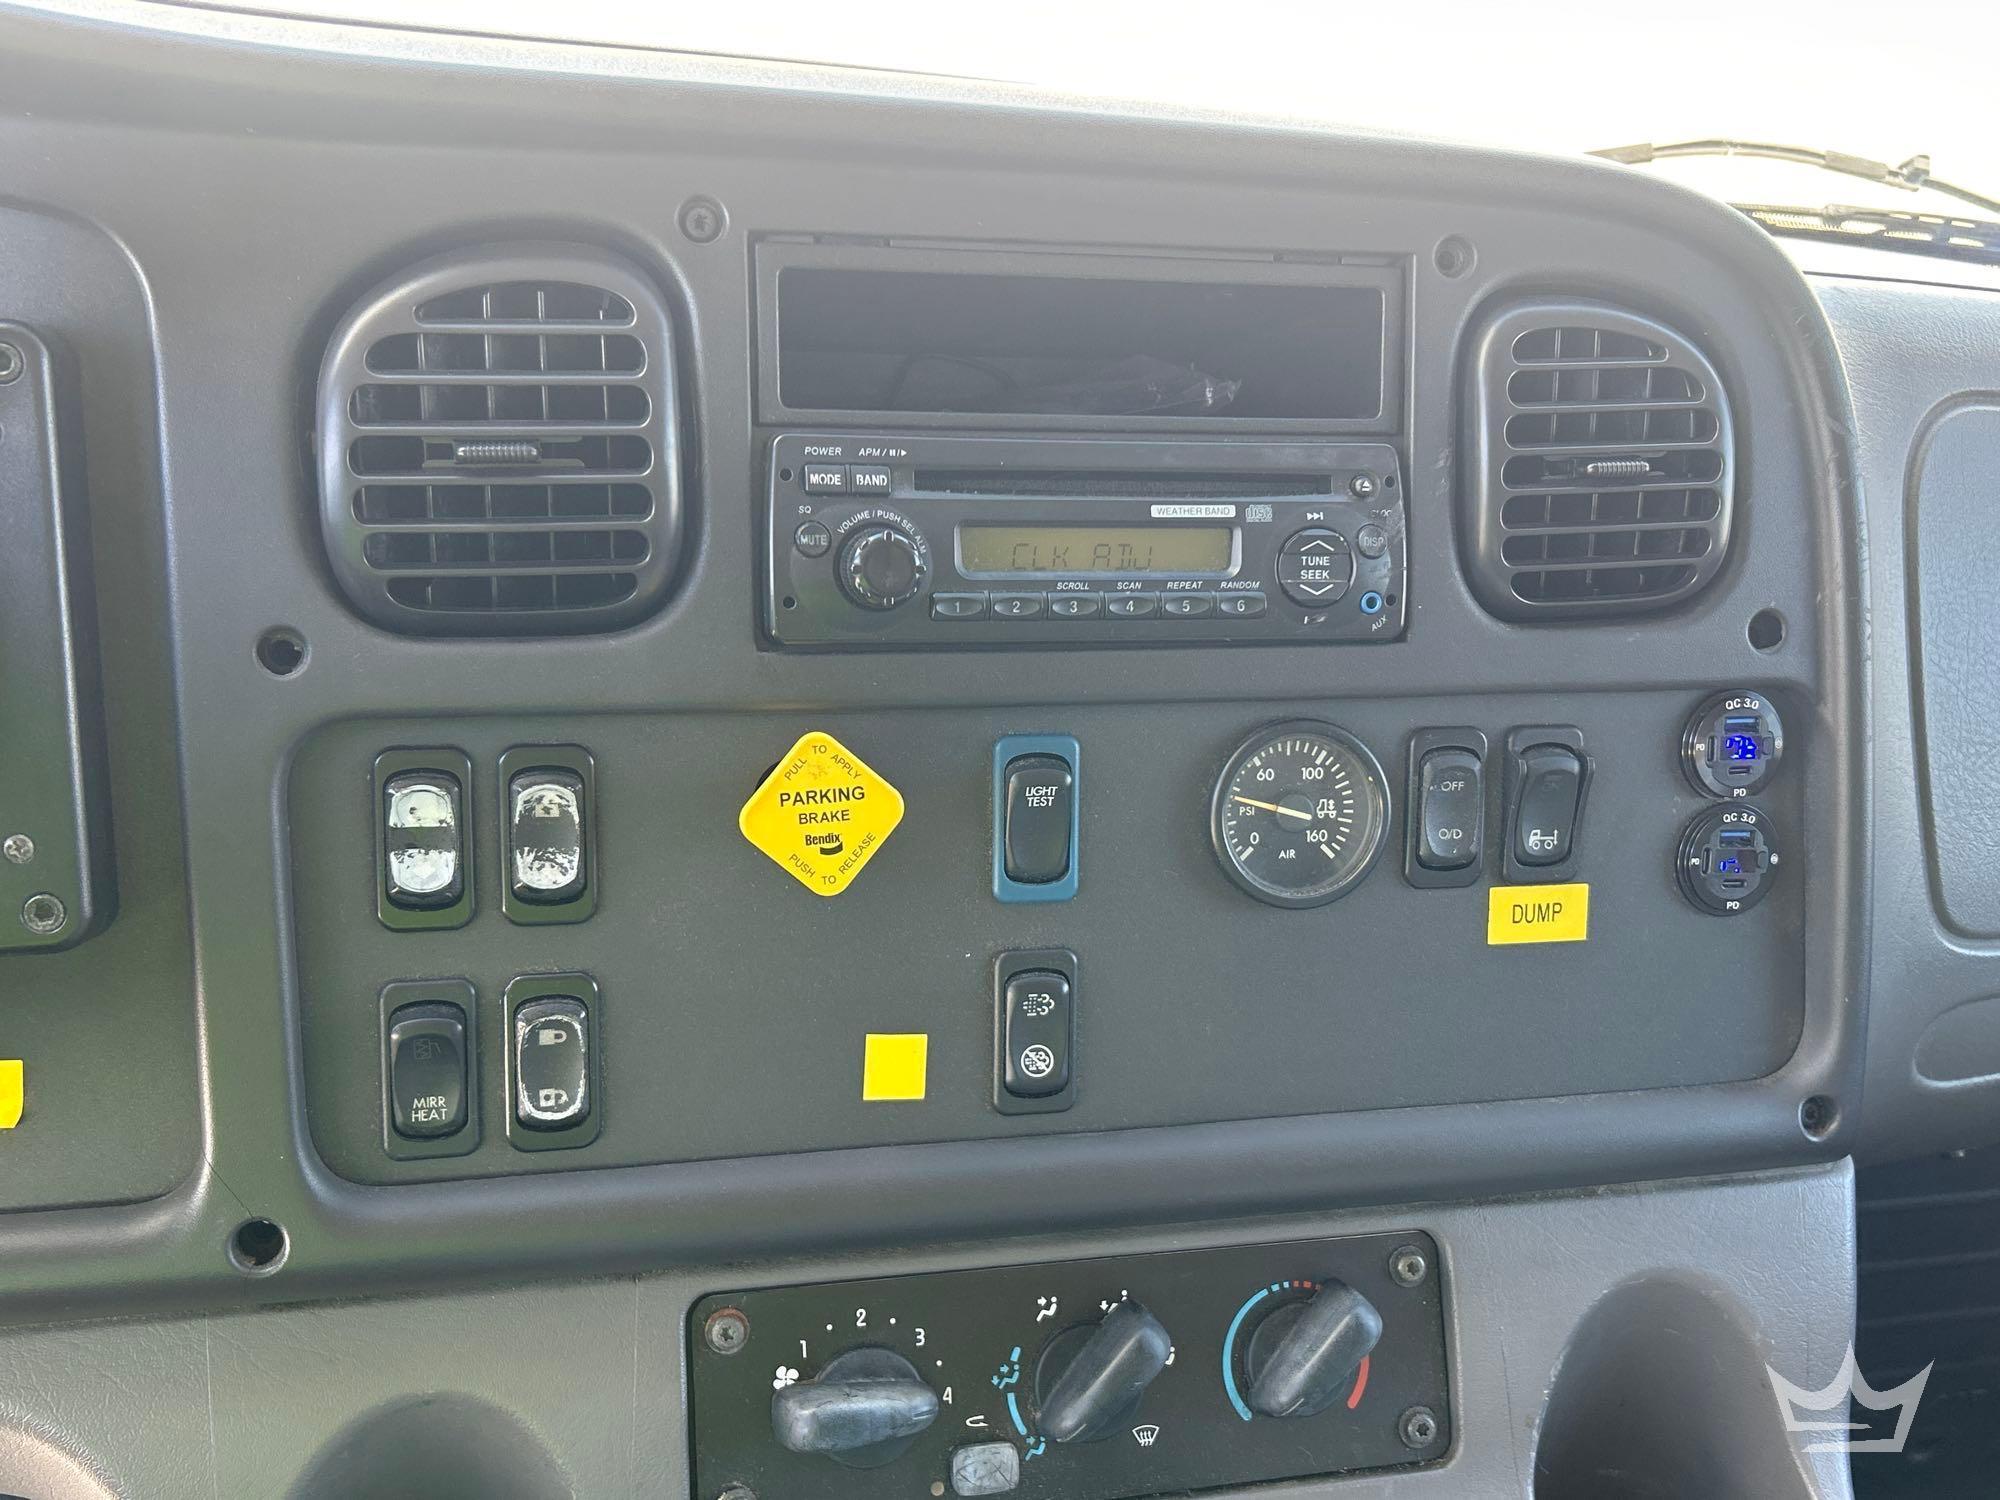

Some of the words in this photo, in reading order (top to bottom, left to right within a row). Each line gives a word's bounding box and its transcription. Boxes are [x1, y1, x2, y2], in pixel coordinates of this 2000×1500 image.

[804, 446, 842, 456] POWER
[809, 473, 842, 485] MODE
[855, 474, 888, 486] BAND
[798, 506, 812, 515] SQ
[1157, 506, 1202, 516] WEATHER
[1204, 506, 1230, 516] BAND
[837, 510, 871, 535] VOLUME
[877, 510, 901, 522] PUSH
[901, 519, 915, 535] SEL
[915, 535, 927, 554] ALM
[800, 535, 828, 546] MUTE
[1364, 536, 1385, 548] DISP
[1011, 543, 1068, 571] CLK
[1301, 555, 1331, 567] TUNE
[1300, 569, 1330, 580] SEEK
[1056, 581, 1090, 590] SCROLL
[1116, 581, 1142, 590] SCAN
[1167, 581, 1203, 590] REPEAT
[1220, 581, 1260, 590] RANDOM
[953, 602, 961, 613] 1
[1012, 601, 1021, 613] 2
[1069, 601, 1078, 613] 3
[1126, 600, 1135, 612] 4
[1182, 600, 1191, 612] 5
[1236, 600, 1245, 612] 6
[1371, 614, 1386, 632] AUX
[1725, 698, 1741, 710] QC
[1743, 697, 1760, 710] 3.0
[784, 757, 808, 781] PULL
[812, 744, 827, 755] TO
[830, 753, 862, 780] APPLY
[1256, 768, 1275, 781] 60
[1301, 767, 1324, 780] 100
[1025, 786, 1058, 797] LIGHT
[1441, 780, 1465, 791] OFF
[779, 786, 865, 807] PARKING
[1733, 788, 1747, 797] PD
[1027, 796, 1055, 807] TEST
[798, 809, 851, 825] BRAKE
[1239, 806, 1255, 816] PSI
[1723, 812, 1738, 823] QC
[1740, 812, 1756, 824] 3.0
[805, 832, 841, 846] Bendix
[1250, 831, 1260, 845] 0
[1306, 829, 1328, 843] 160
[1438, 828, 1463, 840] O/D
[789, 853, 816, 878] PUSH
[821, 875, 837, 885] TO
[838, 832, 877, 875] RELEASE
[1278, 849, 1296, 859] AIR
[1726, 901, 1740, 910] PD
[1511, 902, 1563, 924] DUMP
[412, 1096, 446, 1109] MIRR
[411, 1108, 448, 1123] HEAT
[855, 1308, 867, 1327] 2
[915, 1328, 926, 1346] 3
[799, 1339, 808, 1358] 1
[942, 1386, 953, 1405] 4
